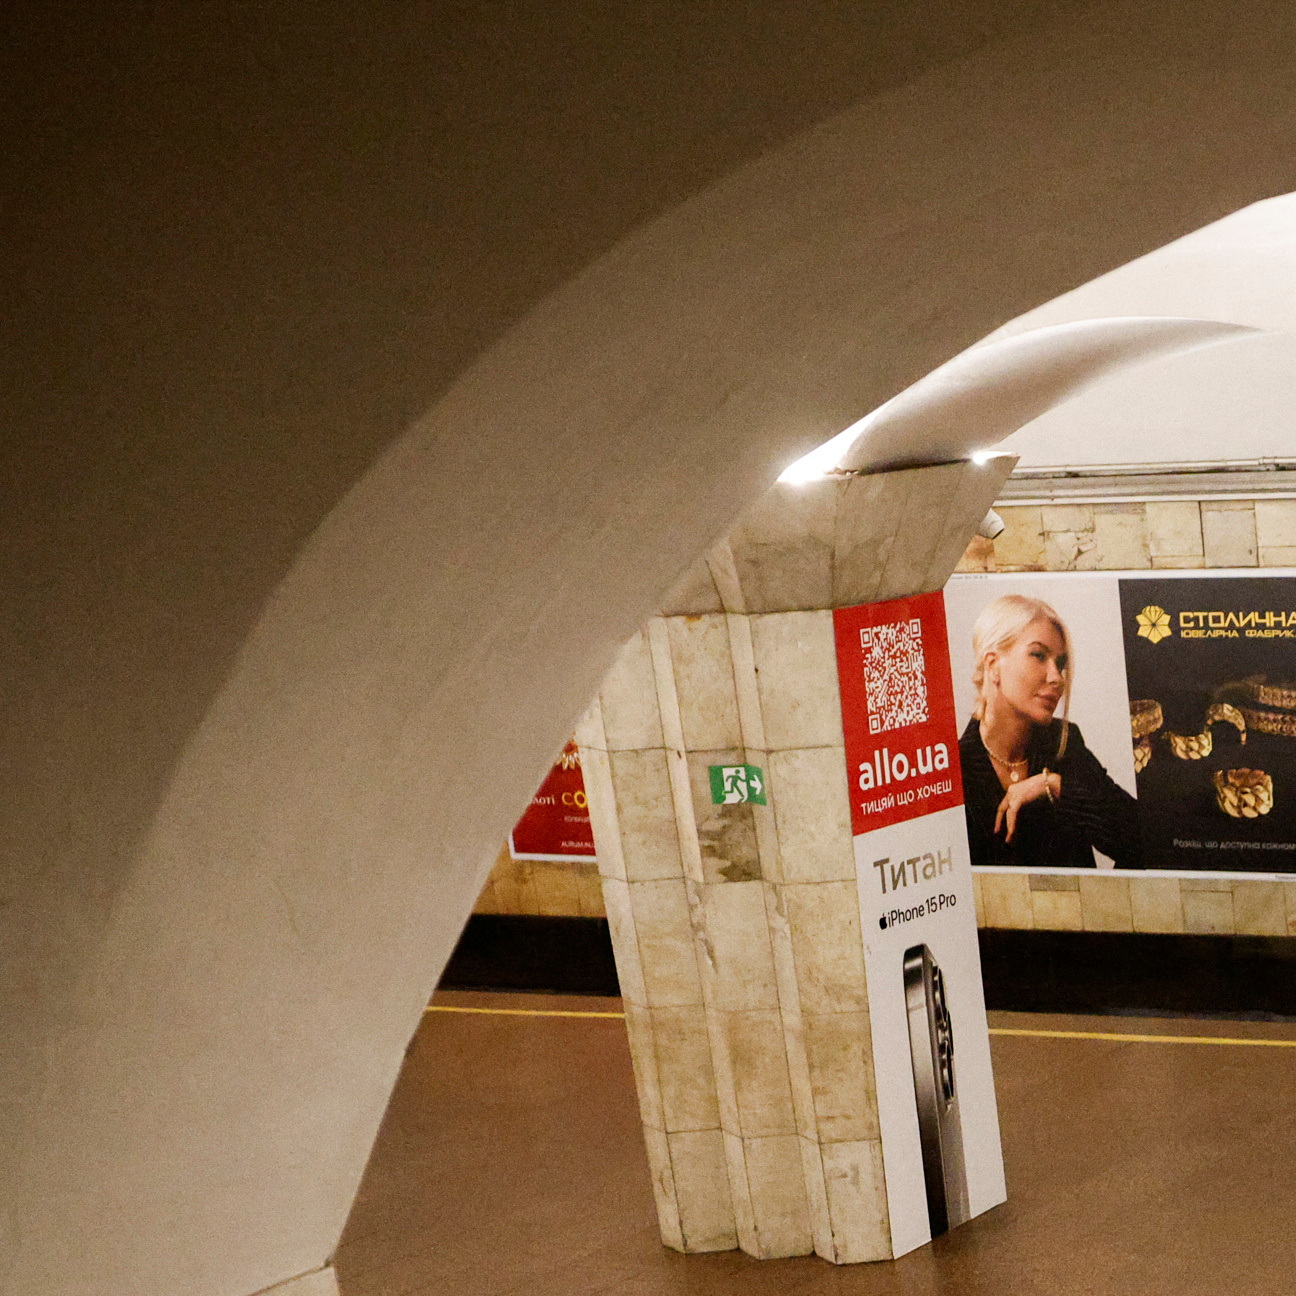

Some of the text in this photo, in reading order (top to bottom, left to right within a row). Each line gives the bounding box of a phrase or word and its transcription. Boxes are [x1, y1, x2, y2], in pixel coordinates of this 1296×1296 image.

[1180, 629, 1240, 639] ЮВЕЛІРНА
[858, 742, 950, 791] allo.ua
[860, 779, 953, 816] ТИЦЯЙ ЩО ХОЧЕШ
[873, 847, 953, 894] Титан
[887, 893, 957, 928] iPhone 15 Pro
